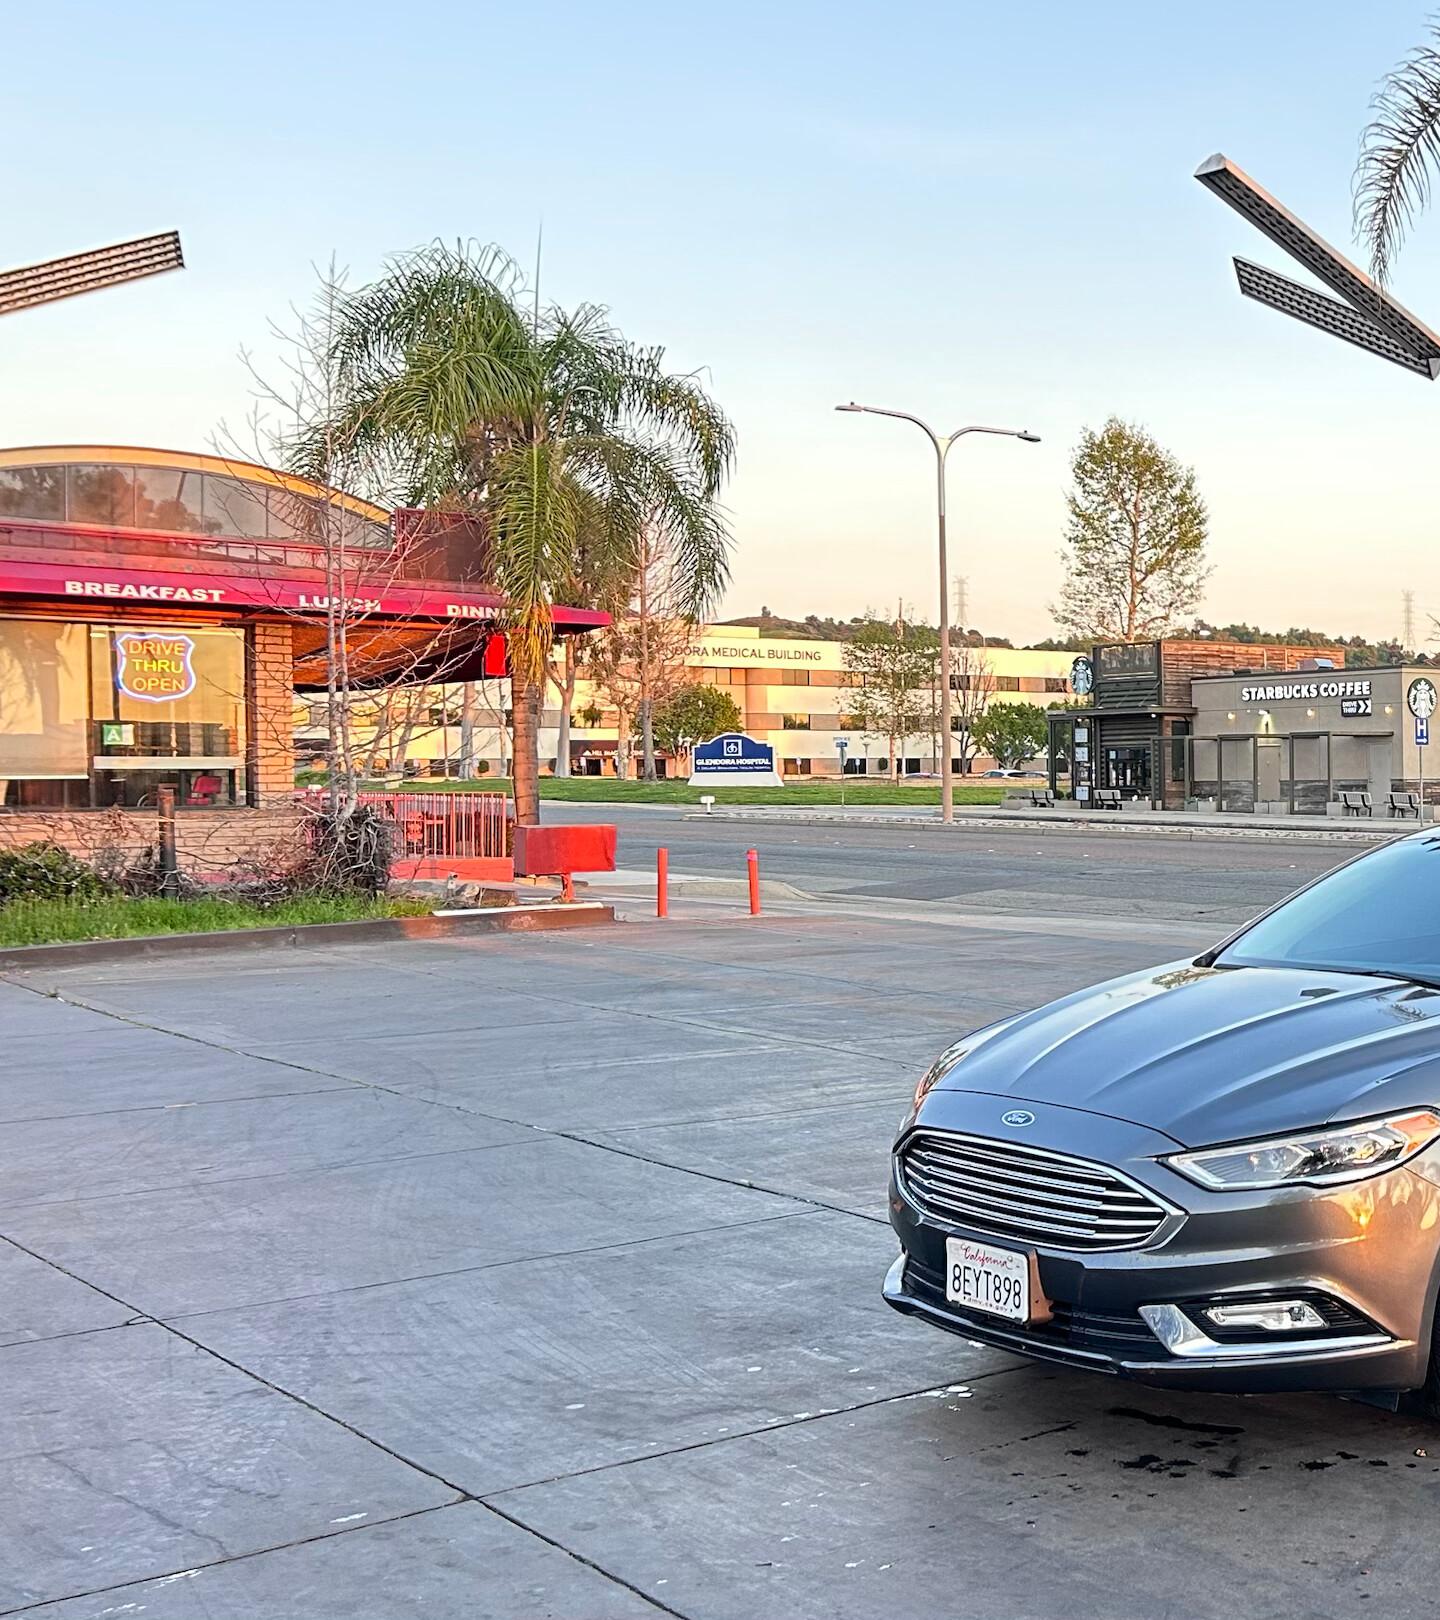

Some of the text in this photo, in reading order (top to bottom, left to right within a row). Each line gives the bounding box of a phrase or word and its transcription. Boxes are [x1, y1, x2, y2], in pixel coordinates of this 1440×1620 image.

[65, 580, 225, 602] BREAKFAST
[129, 640, 186, 656] DRIVE
[712, 647, 765, 659] MEDICAL
[768, 649, 822, 661] BUILDING
[132, 658, 184, 674] THRU
[132, 677, 185, 692] OPEN
[1241, 681, 1372, 702] STARBUCKS COFFEE
[107, 728, 120, 741] A
[1416, 718, 1427, 737] H
[696, 758, 771, 766] GLENDORA HOSPITAL
[952, 1263, 1022, 1310] 8EYT898
